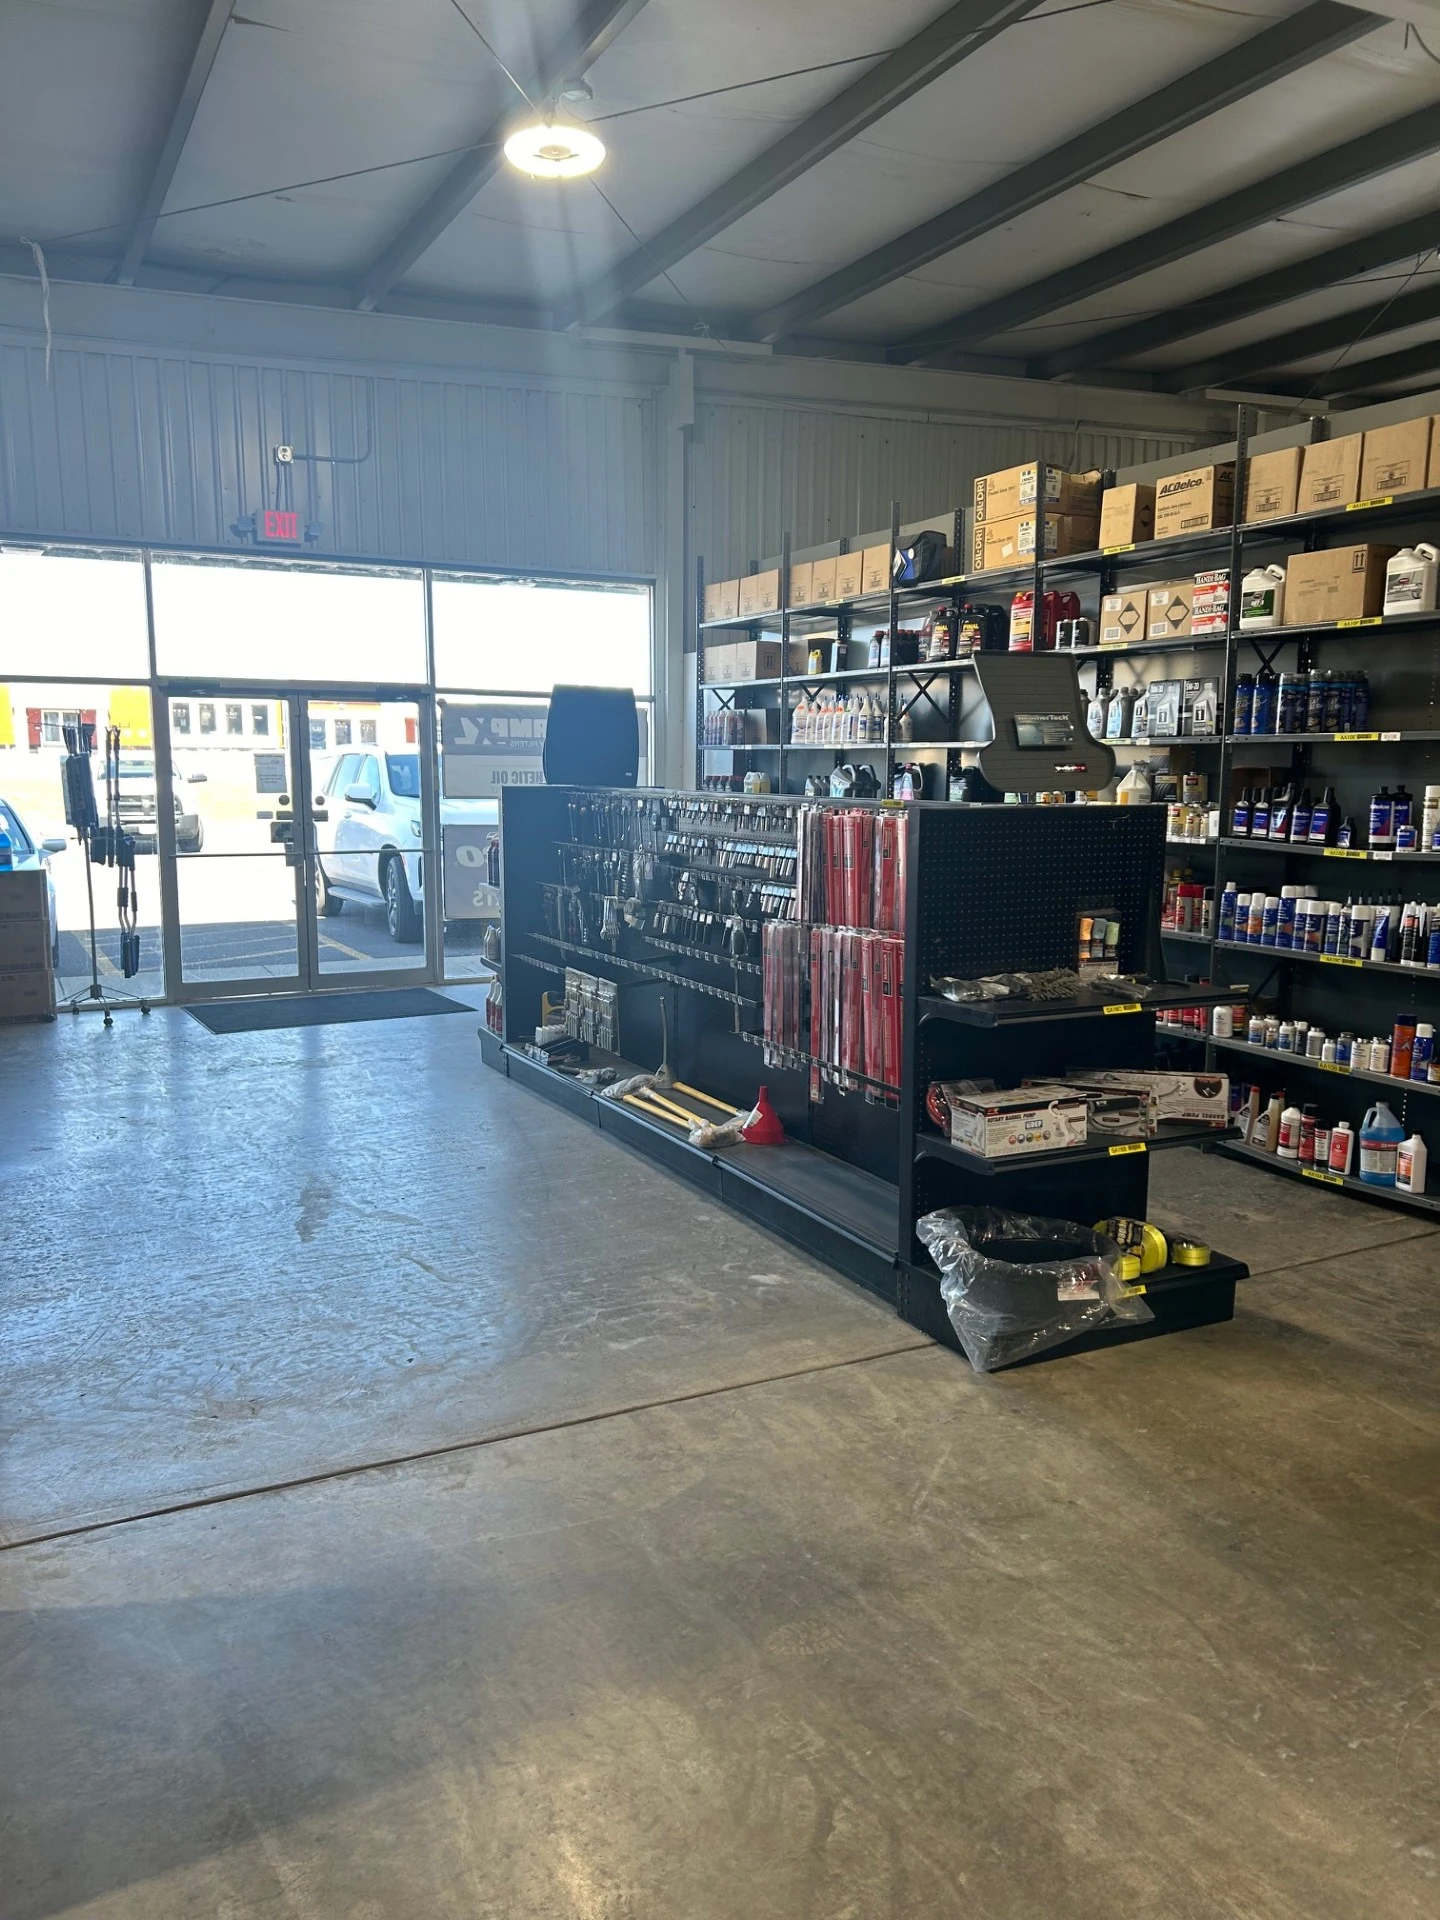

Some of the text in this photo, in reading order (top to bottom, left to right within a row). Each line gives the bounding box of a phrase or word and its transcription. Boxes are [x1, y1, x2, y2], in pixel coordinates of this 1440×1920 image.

[1159, 478, 1203, 495] ACDelco
[264, 511, 298, 539] EXIT
[1196, 573, 1226, 584] HANDI-BAG
